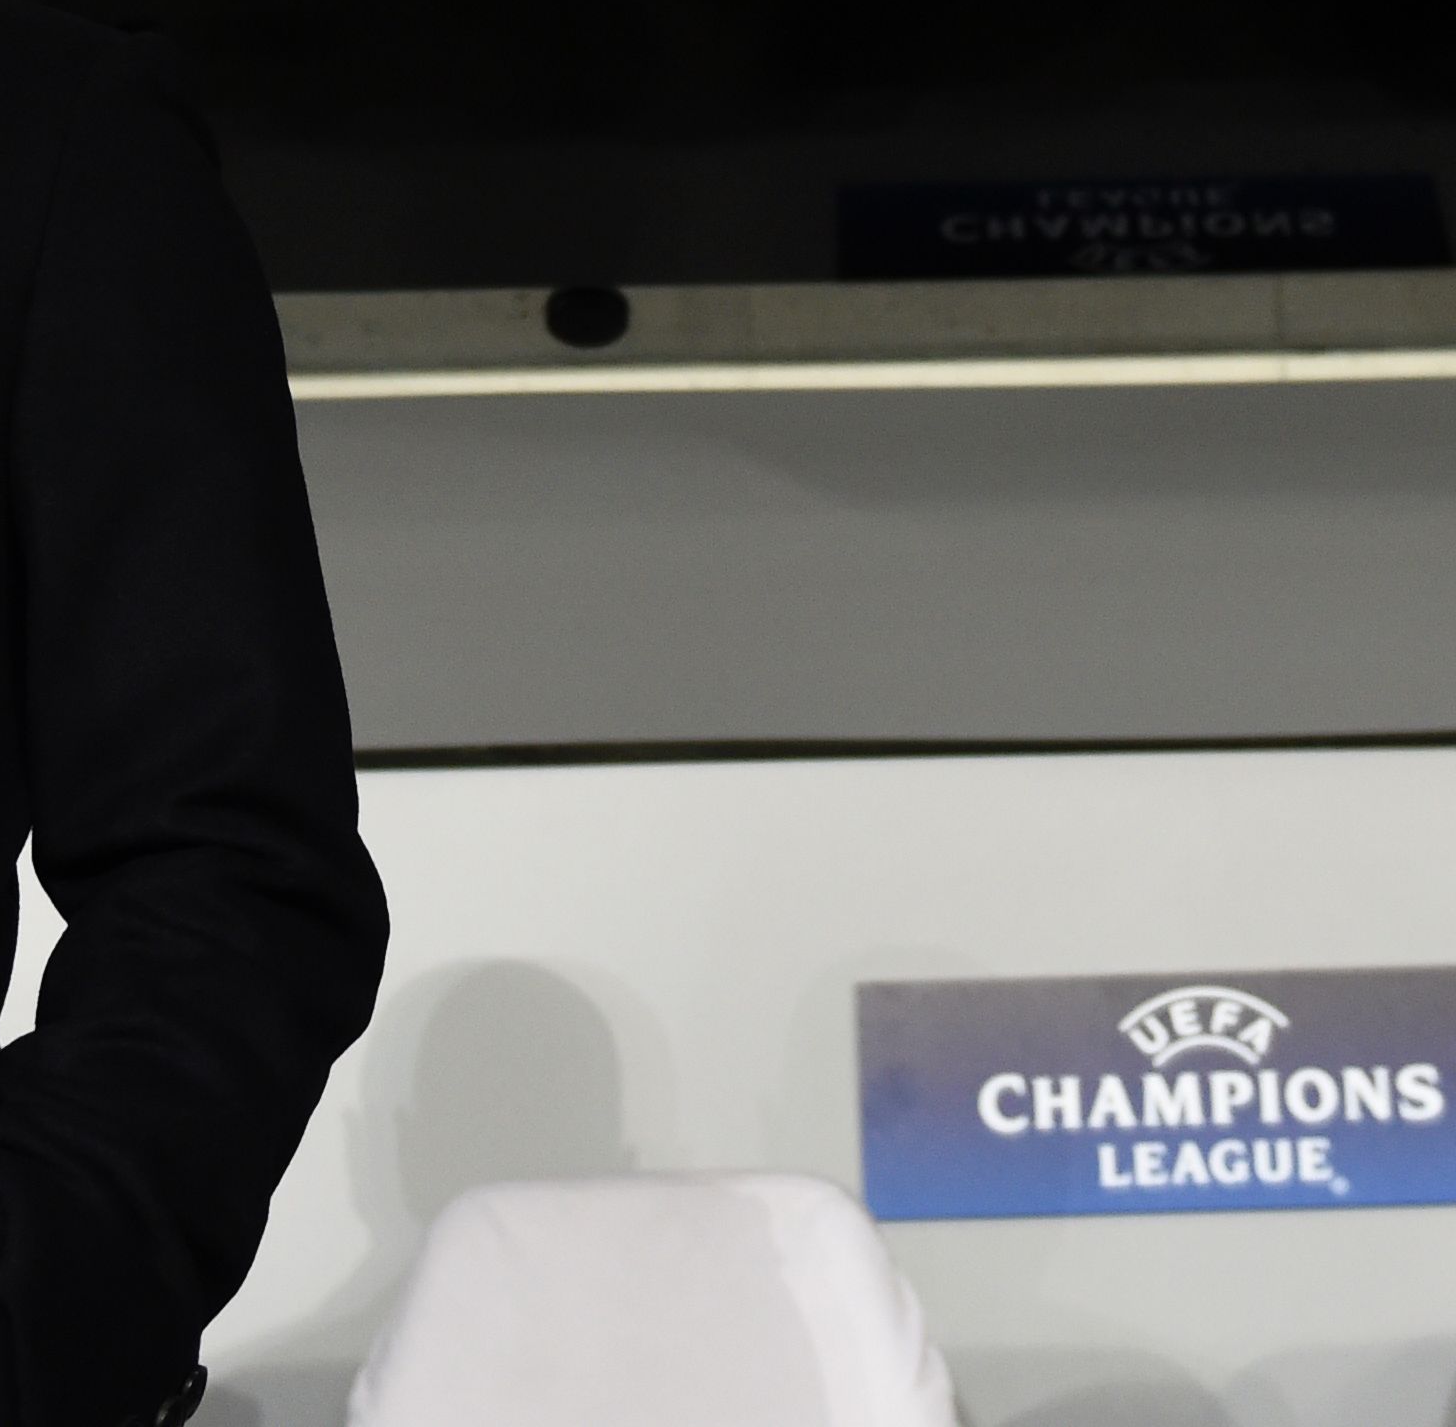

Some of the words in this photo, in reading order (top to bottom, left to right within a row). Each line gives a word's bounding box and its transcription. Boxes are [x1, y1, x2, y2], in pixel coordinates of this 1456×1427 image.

[1126, 996, 1274, 1056] UEFA
[977, 1063, 1446, 1134] CHAMPIONS
[1098, 1137, 1335, 1189] LEAGUE
